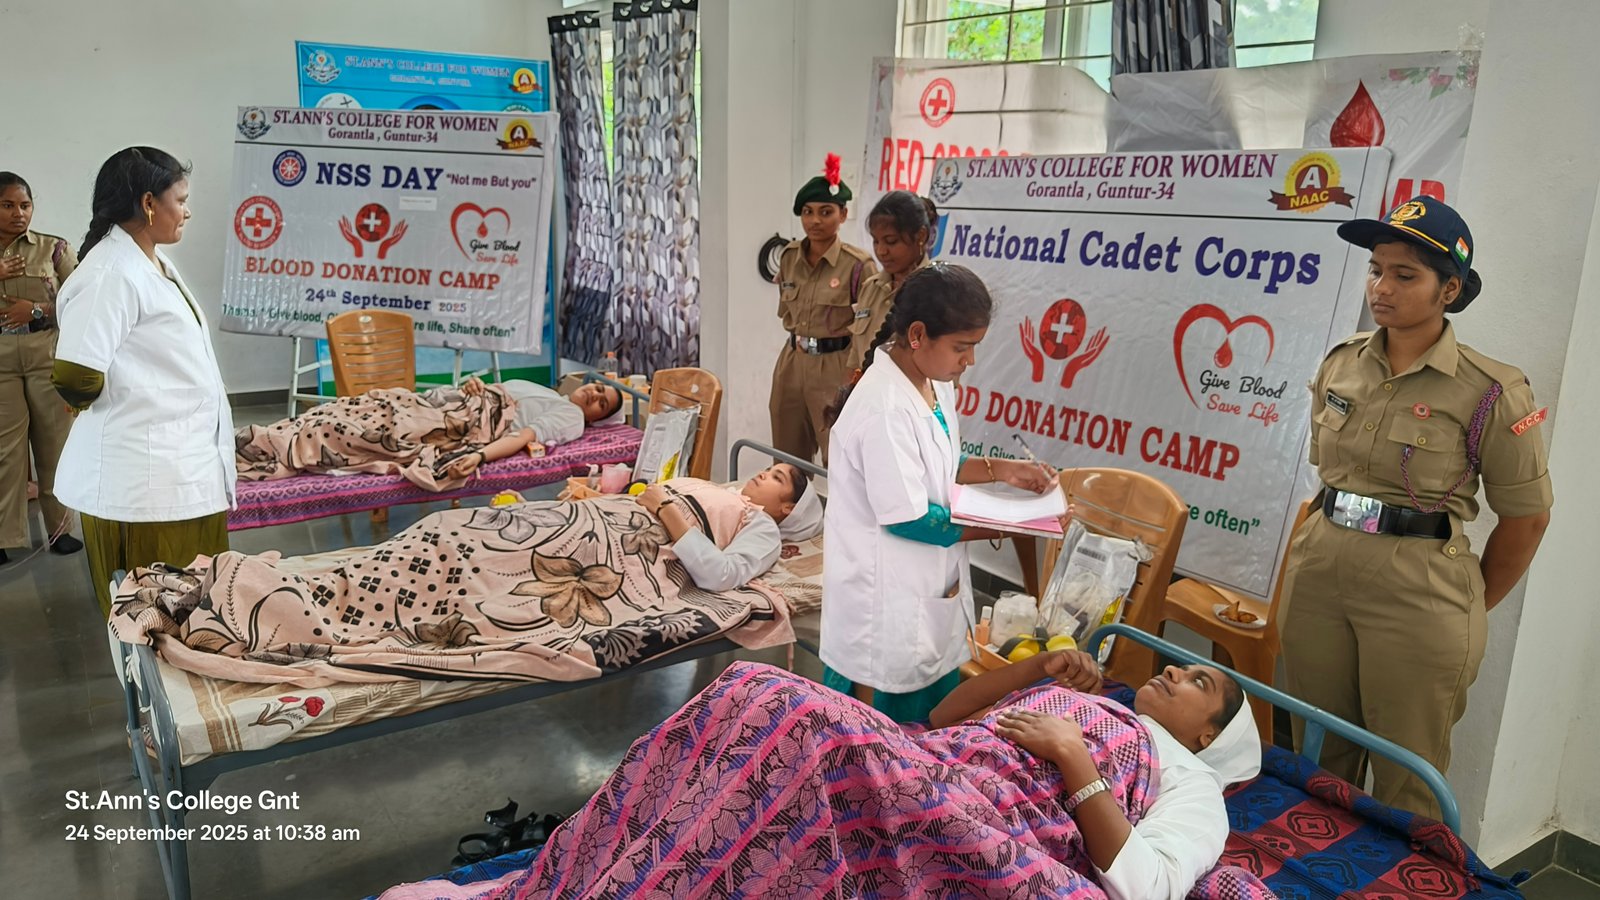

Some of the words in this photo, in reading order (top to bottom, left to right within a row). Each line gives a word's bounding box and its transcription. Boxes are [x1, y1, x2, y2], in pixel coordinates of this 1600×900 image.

[397, 60, 445, 73] COLLEGE
[448, 63, 467, 74] FOR
[471, 65, 510, 78] WOMEN
[273, 109, 333, 126] ST.ANN'S
[337, 112, 401, 129] COLLEGE
[406, 114, 435, 130] FOR
[438, 116, 499, 132] WOMEN
[328, 128, 374, 140] Gorantla
[383, 130, 438, 143] Guntur-34
[315, 161, 371, 187] NSS
[381, 165, 444, 191] DAY
[878, 137, 924, 193] RED
[966, 157, 1038, 178] ST.ANN'S
[1040, 155, 1127, 178] COLLEGE
[1128, 154, 1175, 178] FOR
[1181, 153, 1279, 178] WOMEN
[472, 177, 488, 186] me
[491, 175, 509, 187] But
[1026, 181, 1084, 198] Gorantla
[1096, 181, 1176, 200] Guntur-34
[1290, 190, 1329, 208] NAAC
[470, 239, 488, 253] Give
[493, 240, 521, 252] Blood
[950, 223, 1071, 263] National
[1079, 230, 1182, 273] Cadet
[1195, 236, 1321, 294] Corps
[244, 257, 315, 277] BLOOD
[322, 262, 432, 286] DONATION
[439, 270, 500, 291] CAMP
[342, 291, 431, 310] September
[439, 302, 467, 312] 2025
[293, 309, 324, 323] blood,
[427, 321, 446, 335] life,
[449, 322, 480, 335] Share
[1200, 370, 1230, 394] Give
[1239, 376, 1288, 399] Blood
[1207, 393, 1241, 415] Save
[1248, 402, 1279, 427] Life
[985, 391, 1132, 456] DONATION
[1140, 426, 1240, 481] CAMP
